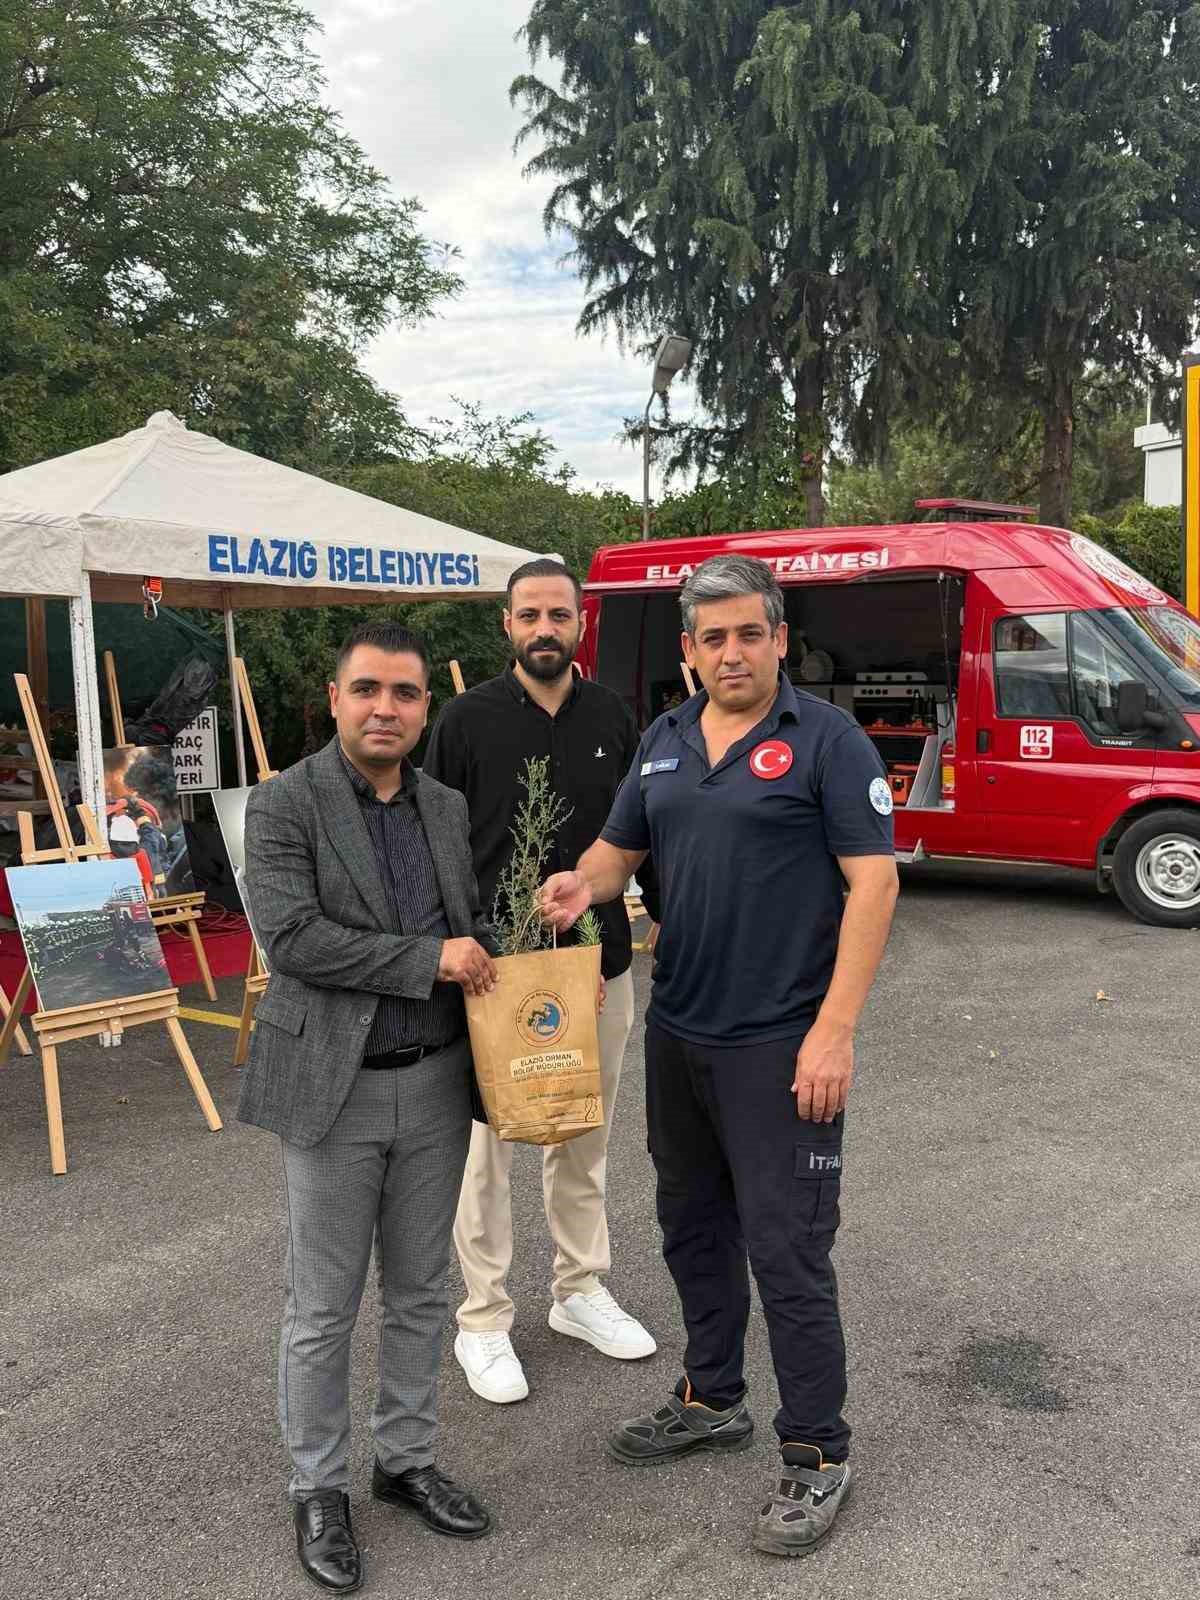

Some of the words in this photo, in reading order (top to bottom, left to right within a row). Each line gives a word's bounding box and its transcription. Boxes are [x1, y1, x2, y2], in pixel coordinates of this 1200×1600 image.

[208, 535, 318, 579] ELAZIĞ
[328, 546, 480, 586] BELEDİYESİ
[175, 735, 203, 751] RAÇ
[1025, 729, 1047, 743] 112
[174, 754, 203, 767] ARK
[545, 1053, 572, 1062] ORMAN
